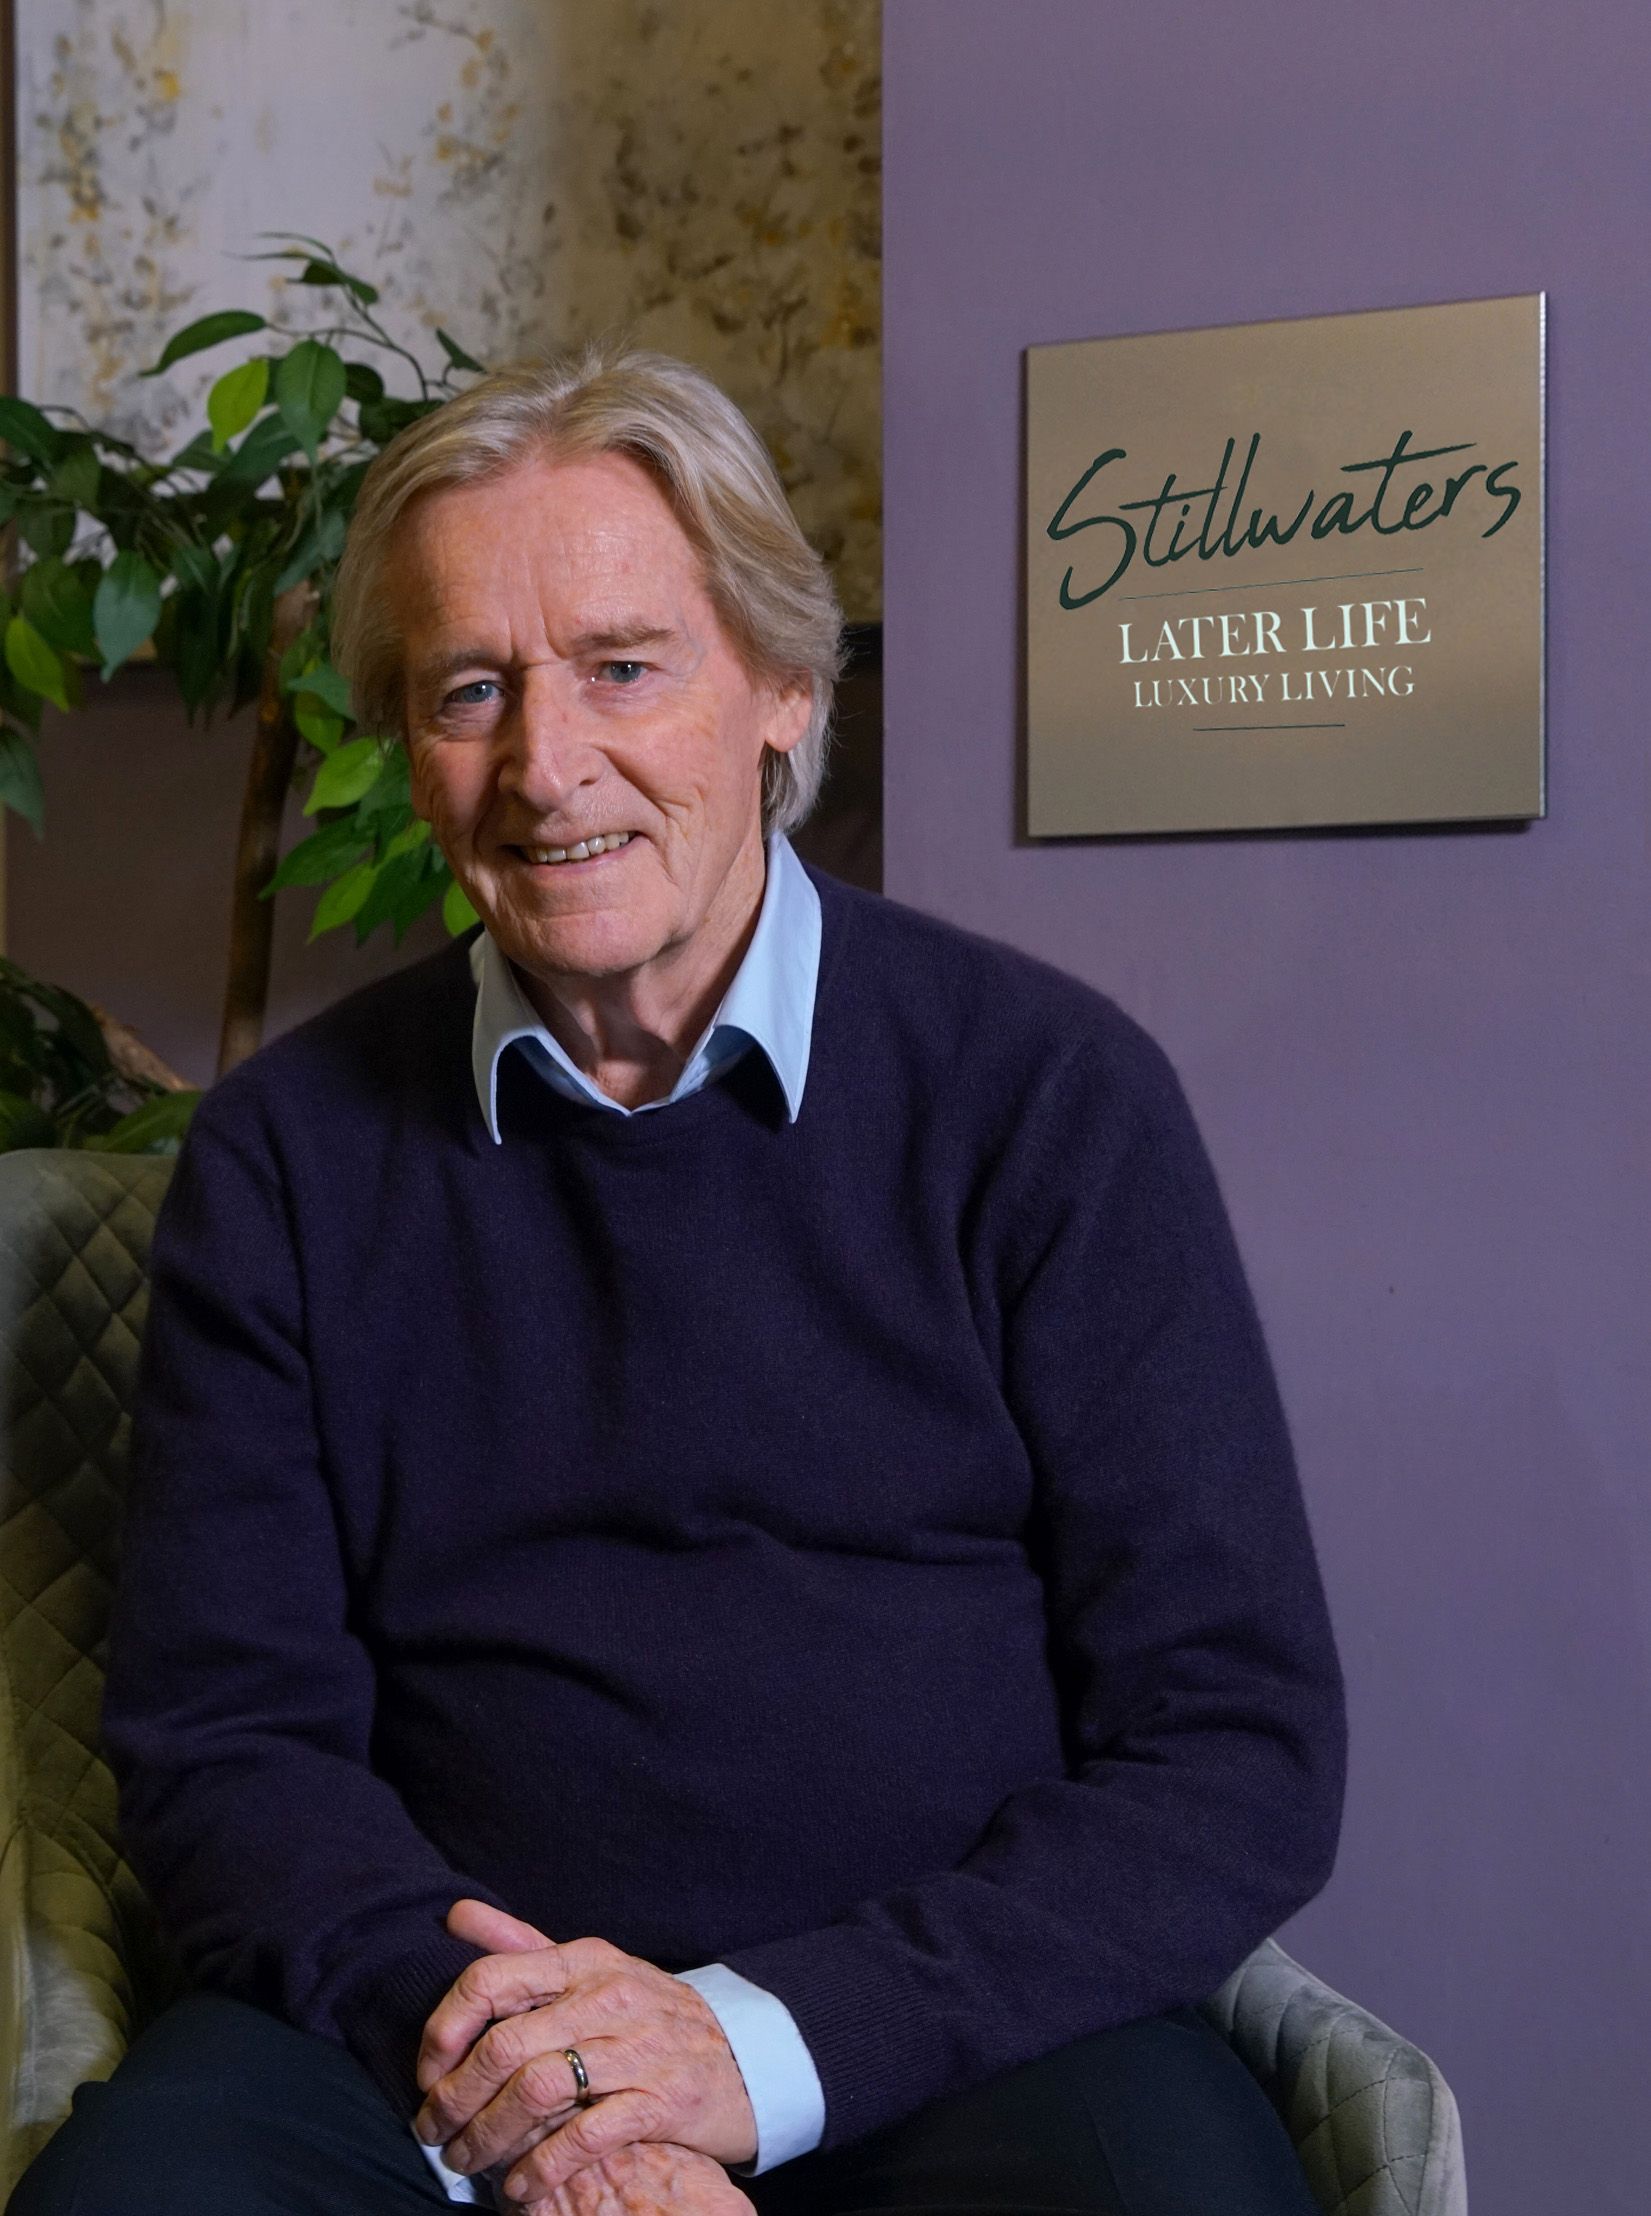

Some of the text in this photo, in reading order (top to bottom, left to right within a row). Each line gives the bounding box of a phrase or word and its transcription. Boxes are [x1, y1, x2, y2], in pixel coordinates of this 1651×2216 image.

[1047, 430, 1521, 610] Stillwaters
[1118, 597, 1432, 664] LATER LIFE
[1133, 665, 1415, 708] LUXURY LIVING
